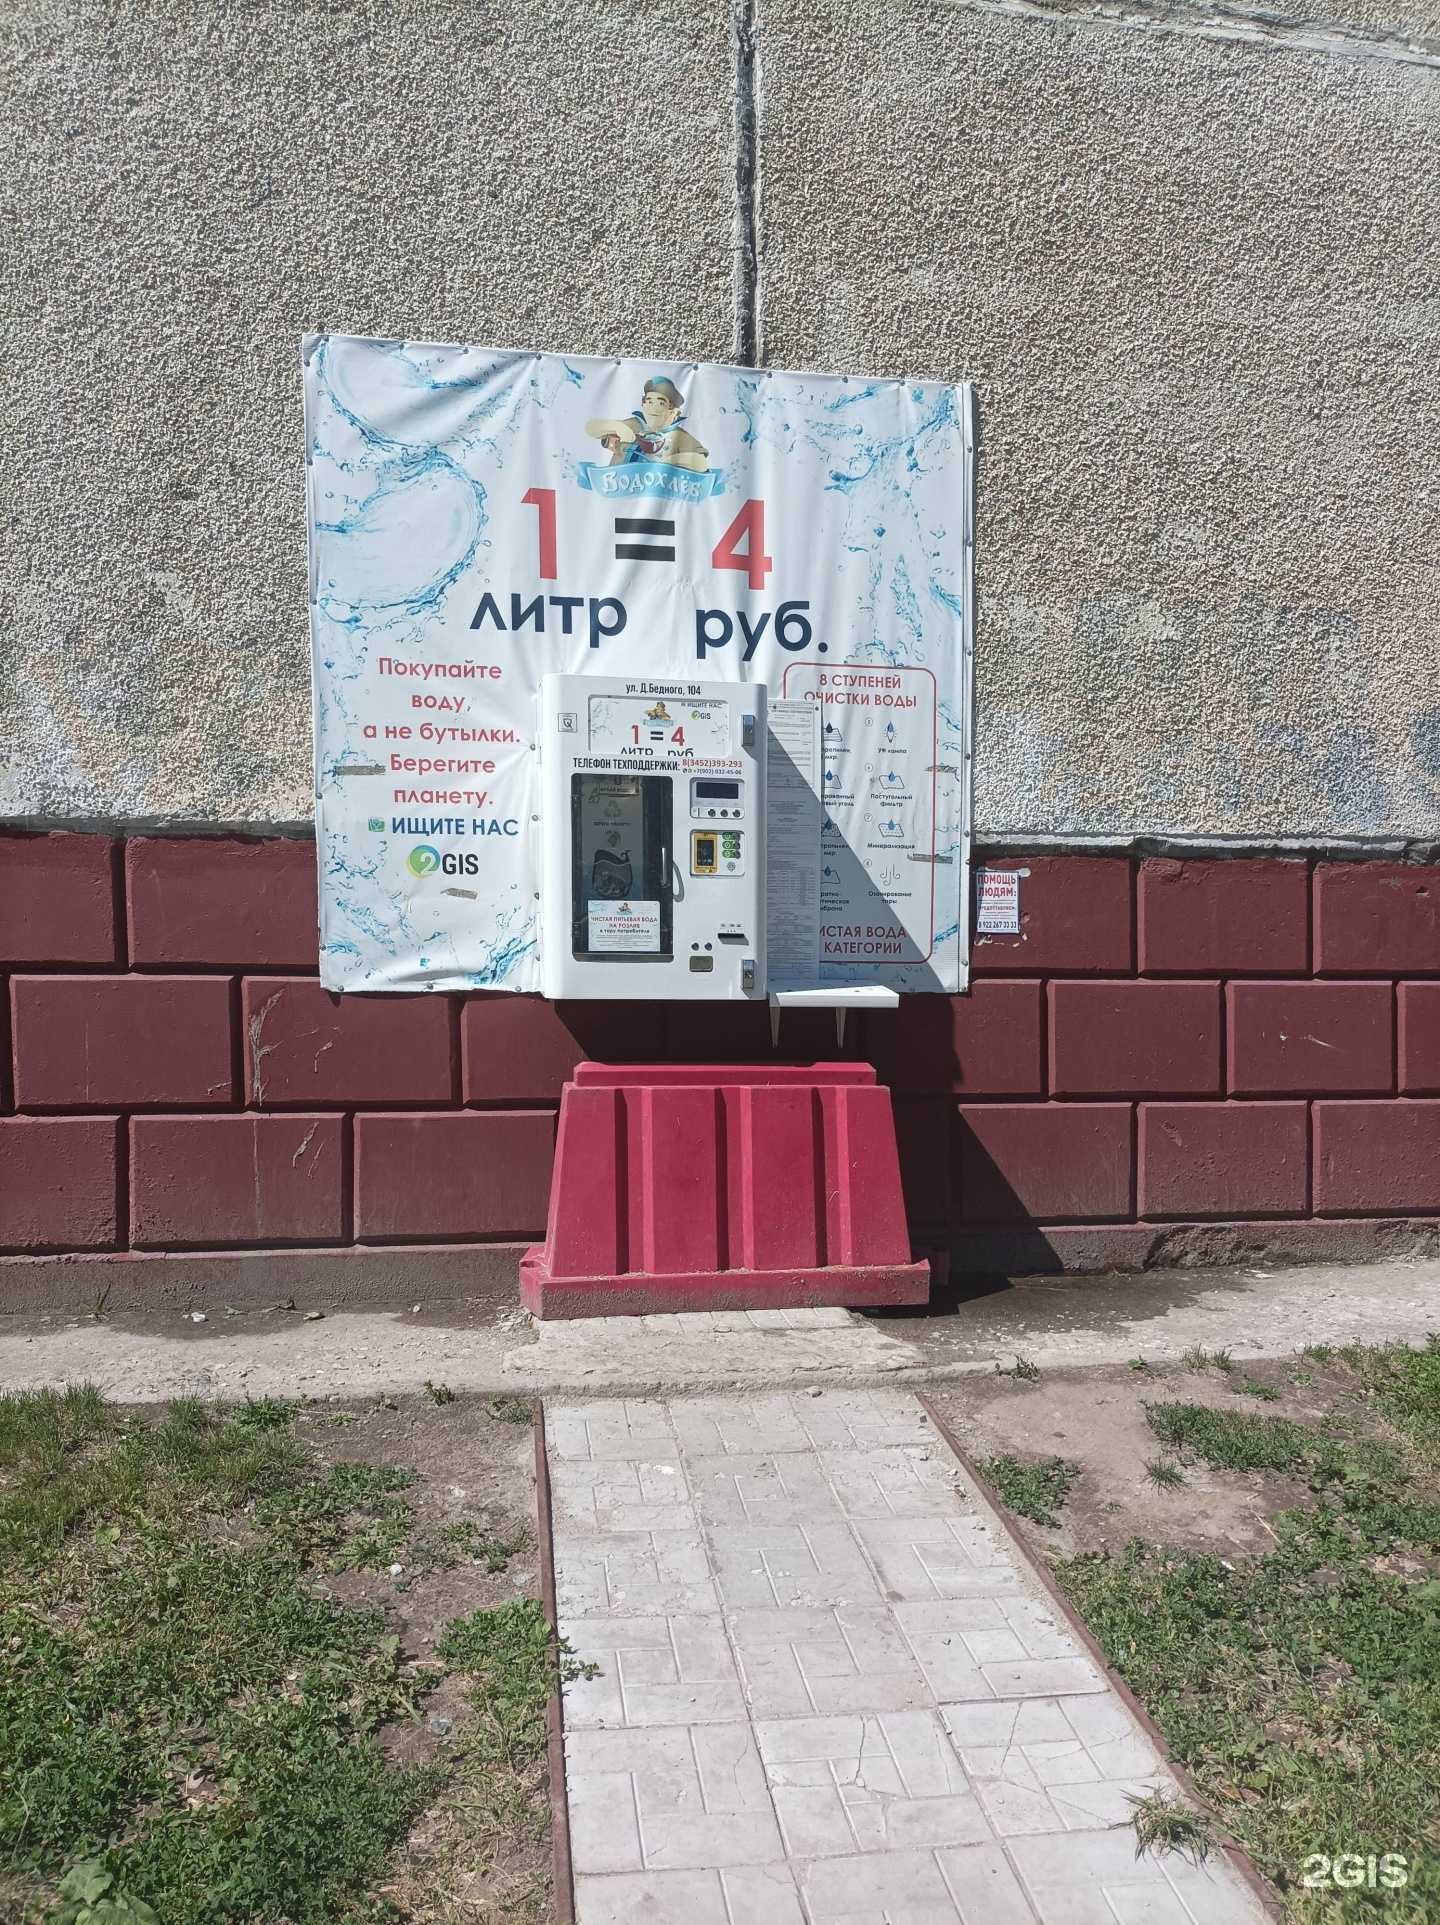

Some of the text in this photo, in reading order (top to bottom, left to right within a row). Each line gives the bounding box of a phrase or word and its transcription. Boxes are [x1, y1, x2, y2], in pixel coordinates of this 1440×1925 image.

[521, 488, 772, 590] 1 = 4
[470, 592, 828, 661] литр руб.
[379, 657, 502, 680] Покупайте
[626, 682, 701, 696] ул. Д.Бедного, 104
[820, 674, 901, 688] 8 СТУПЕНЕЙ
[411, 694, 471, 713] воду,
[804, 691, 917, 708] ОЧИСТКИ ВОДЫ
[363, 723, 520, 744] а не бутылки.
[632, 725, 685, 746] 1 = 4
[390, 754, 496, 775] Берегите
[573, 758, 611, 768] ТЕЛЕФОН
[613, 759, 681, 771] ТЕХПОДДЕРЖКИ:
[394, 789, 493, 808] планету.
[392, 817, 519, 836] ИЩИТЕ НАС
[414, 849, 479, 877] 2GIS
[978, 875, 1016, 887] ПОМОЩЬ
[978, 888, 1016, 898] ЛЮДЯМ:
[820, 926, 907, 940] ИСТАЯ ВОДА
[824, 943, 902, 954] КАТЕГОРИИ
